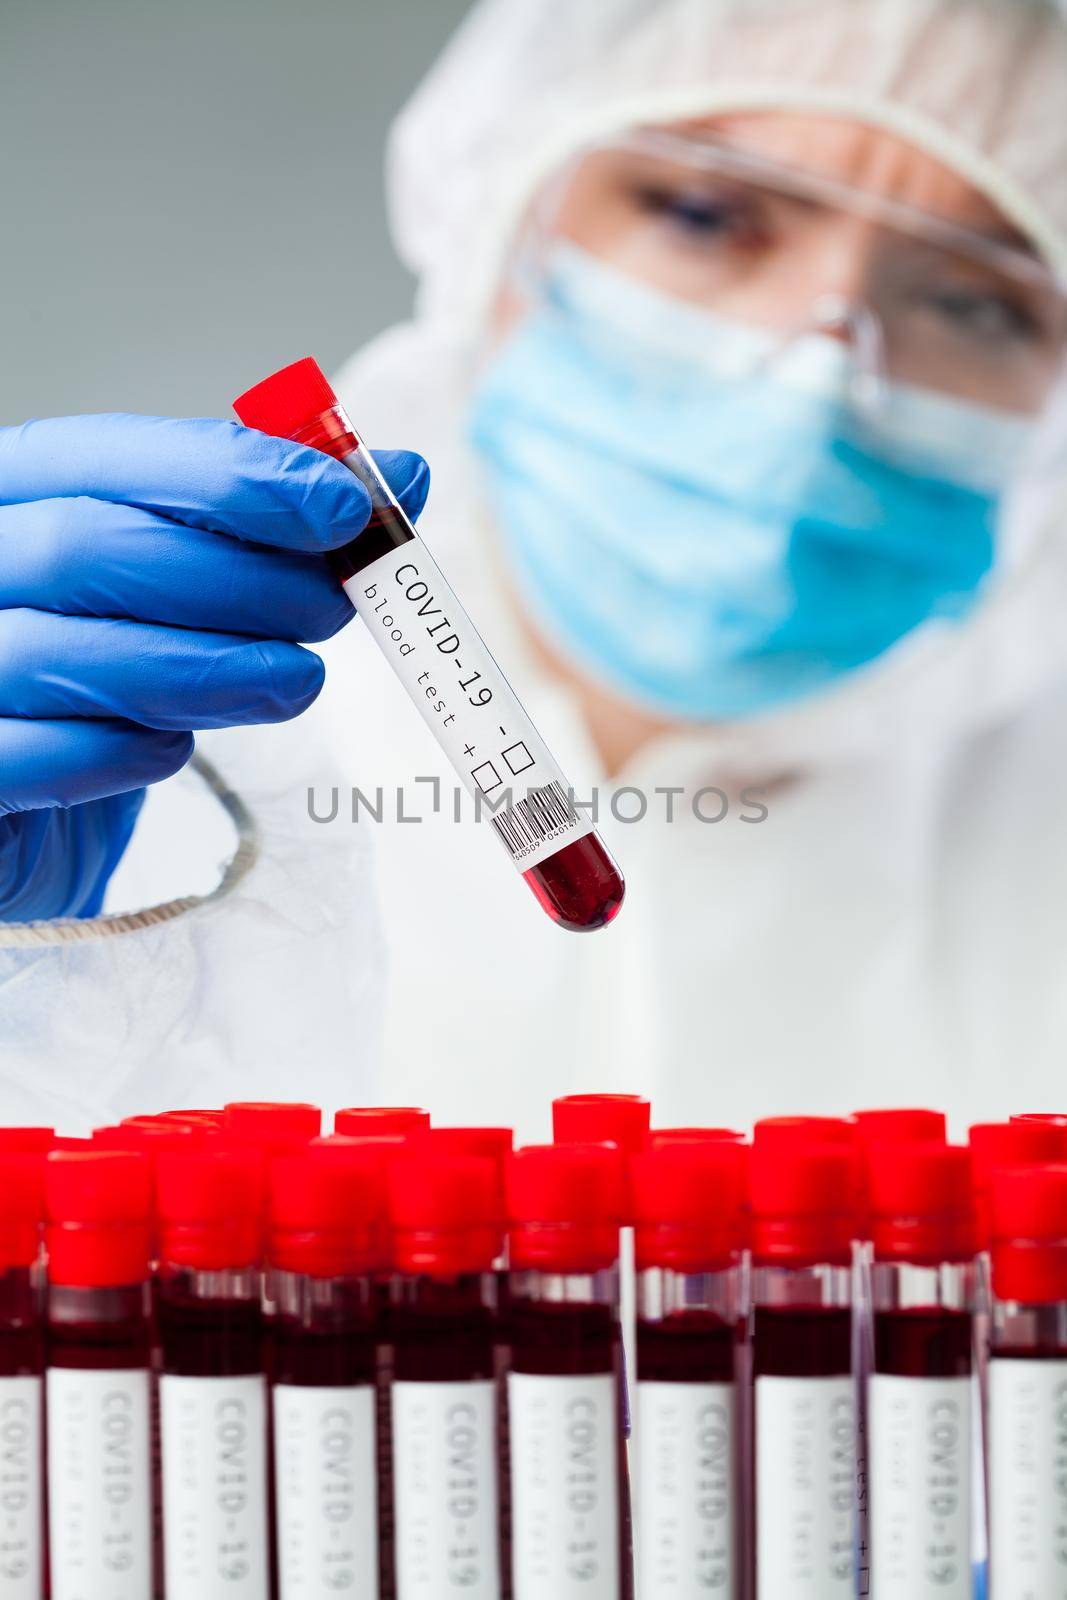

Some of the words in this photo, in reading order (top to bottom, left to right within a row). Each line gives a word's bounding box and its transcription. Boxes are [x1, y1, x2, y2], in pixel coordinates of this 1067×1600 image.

[363, 582, 417, 658] blood
[416, 670, 457, 728] test
[394, 563, 494, 708] COVID-19
[101, 1389, 134, 1573] COVID-19
[214, 1397, 250, 1582] COVID-19
[320, 1406, 356, 1591] COVID-19
[446, 1401, 481, 1588] COVID-19
[565, 1396, 599, 1582] COVID-19
[696, 1402, 729, 1589] COVID-19
[927, 1396, 960, 1586] COVID-19
